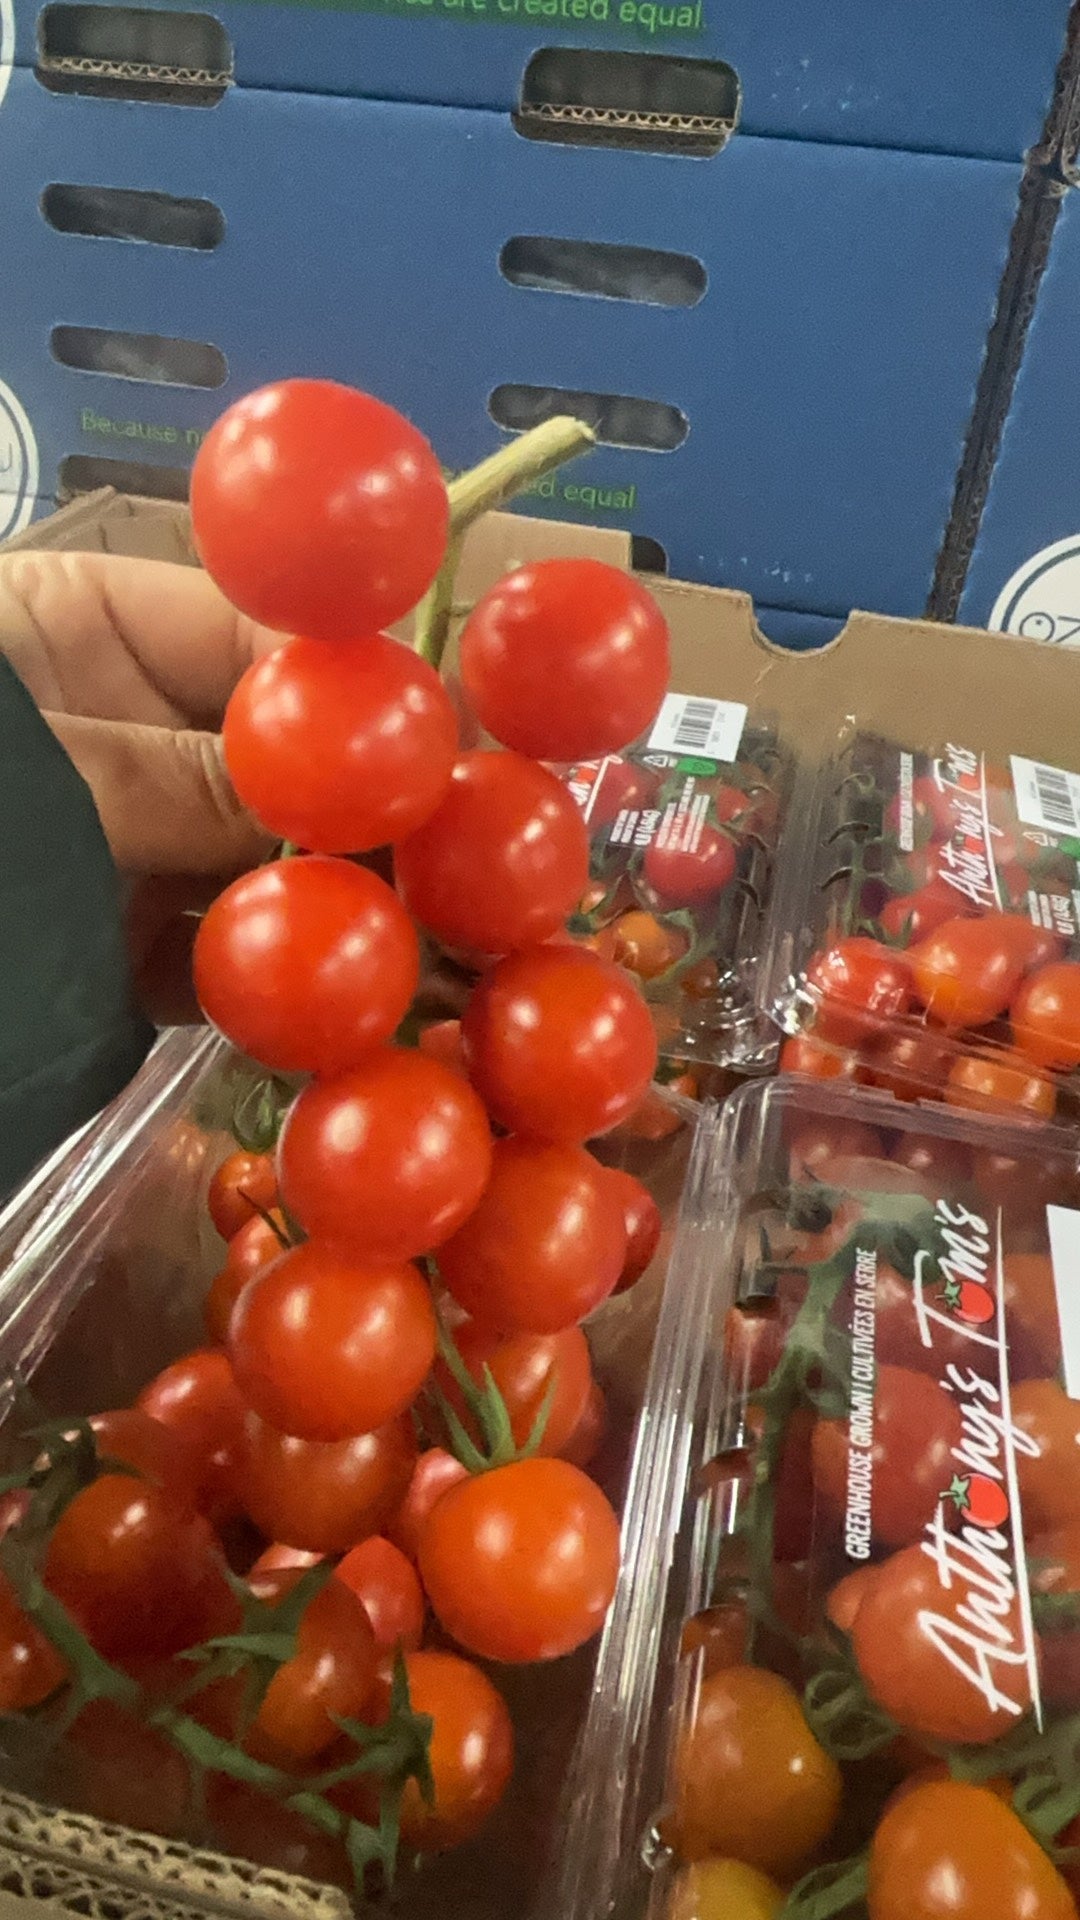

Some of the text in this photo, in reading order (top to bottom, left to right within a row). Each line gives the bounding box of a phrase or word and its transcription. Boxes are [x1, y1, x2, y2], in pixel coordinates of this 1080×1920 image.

[80, 409, 177, 443] Because
[855, 1247, 877, 1288] SERRE
[854, 1289, 876, 1309] EN
[850, 1390, 873, 1447] GROWN
[845, 1448, 872, 1559] GREENHOUSE
